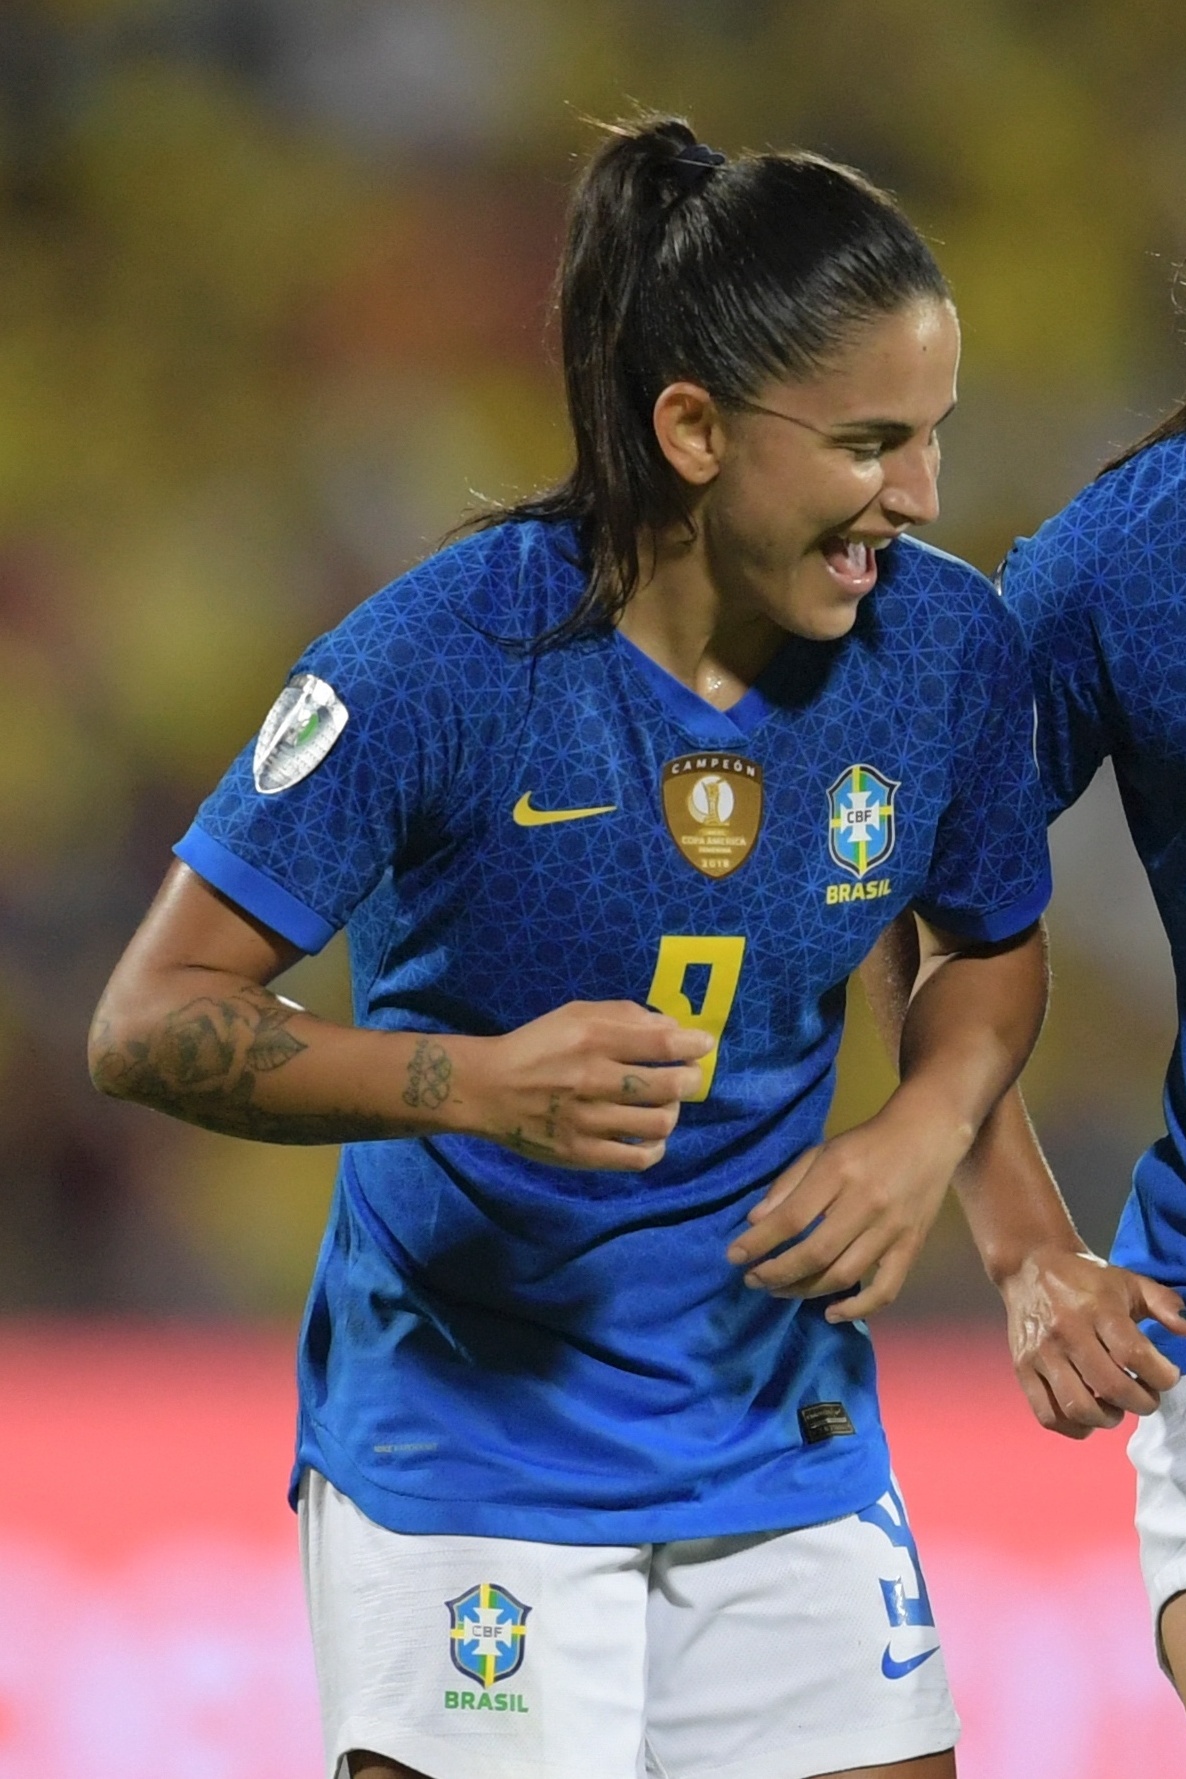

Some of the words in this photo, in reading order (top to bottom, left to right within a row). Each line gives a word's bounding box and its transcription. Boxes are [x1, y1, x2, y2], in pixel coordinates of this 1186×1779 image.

[671, 758, 755, 777] CAMPEÓN
[847, 810, 872, 824] CBF
[682, 836, 705, 845] COPA
[826, 878, 891, 905] BRASIL
[646, 935, 746, 1102] 9
[472, 1625, 503, 1638] CBF
[444, 1691, 529, 1713] BRASIL
